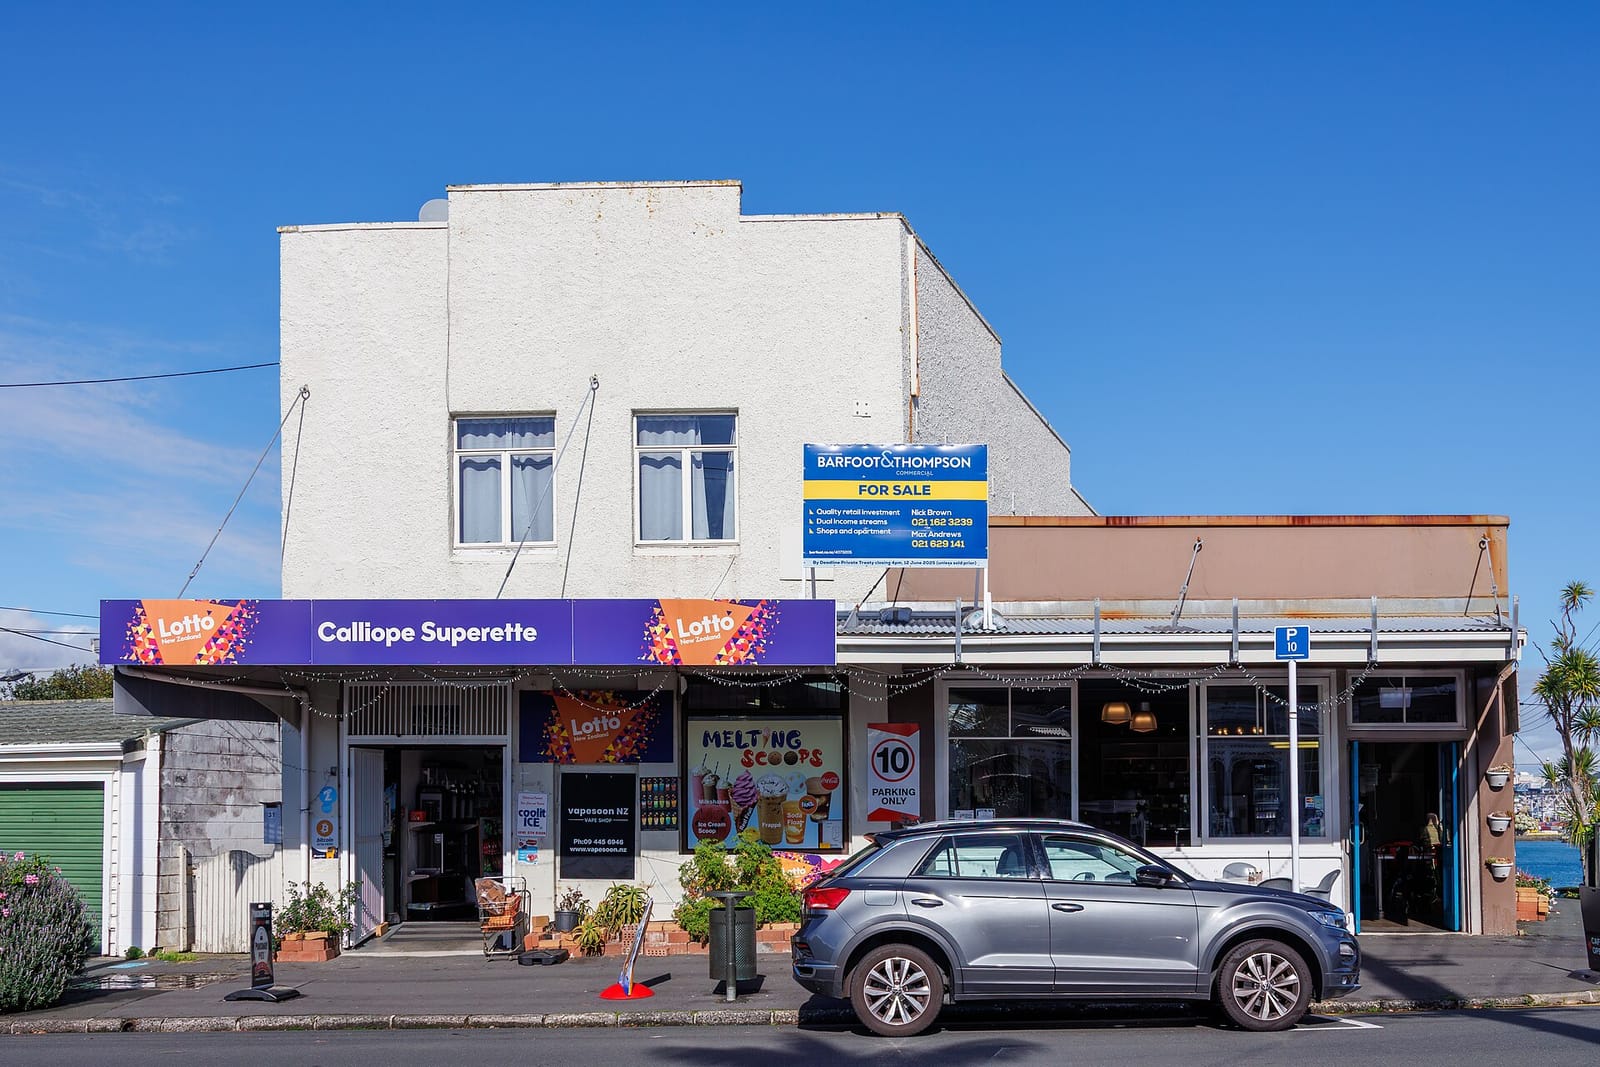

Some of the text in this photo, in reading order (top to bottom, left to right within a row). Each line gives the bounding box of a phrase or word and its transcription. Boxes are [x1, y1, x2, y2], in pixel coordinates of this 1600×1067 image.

[859, 485, 931, 496] FOR SALE
[158, 614, 214, 638] Lotto
[676, 614, 734, 638] Lotto
[176, 633, 202, 642] Zealand
[318, 622, 538, 647] Calliope Superette
[696, 633, 721, 643] Zealand
[1286, 628, 1298, 641] P
[1288, 642, 1297, 652] 10
[571, 716, 620, 736] Lotto
[741, 748, 823, 768] SCOOPS
[876, 746, 910, 773] 10
[518, 808, 546, 818] coolit
[568, 808, 614, 816] vapesoon
[523, 818, 540, 827] ICE
